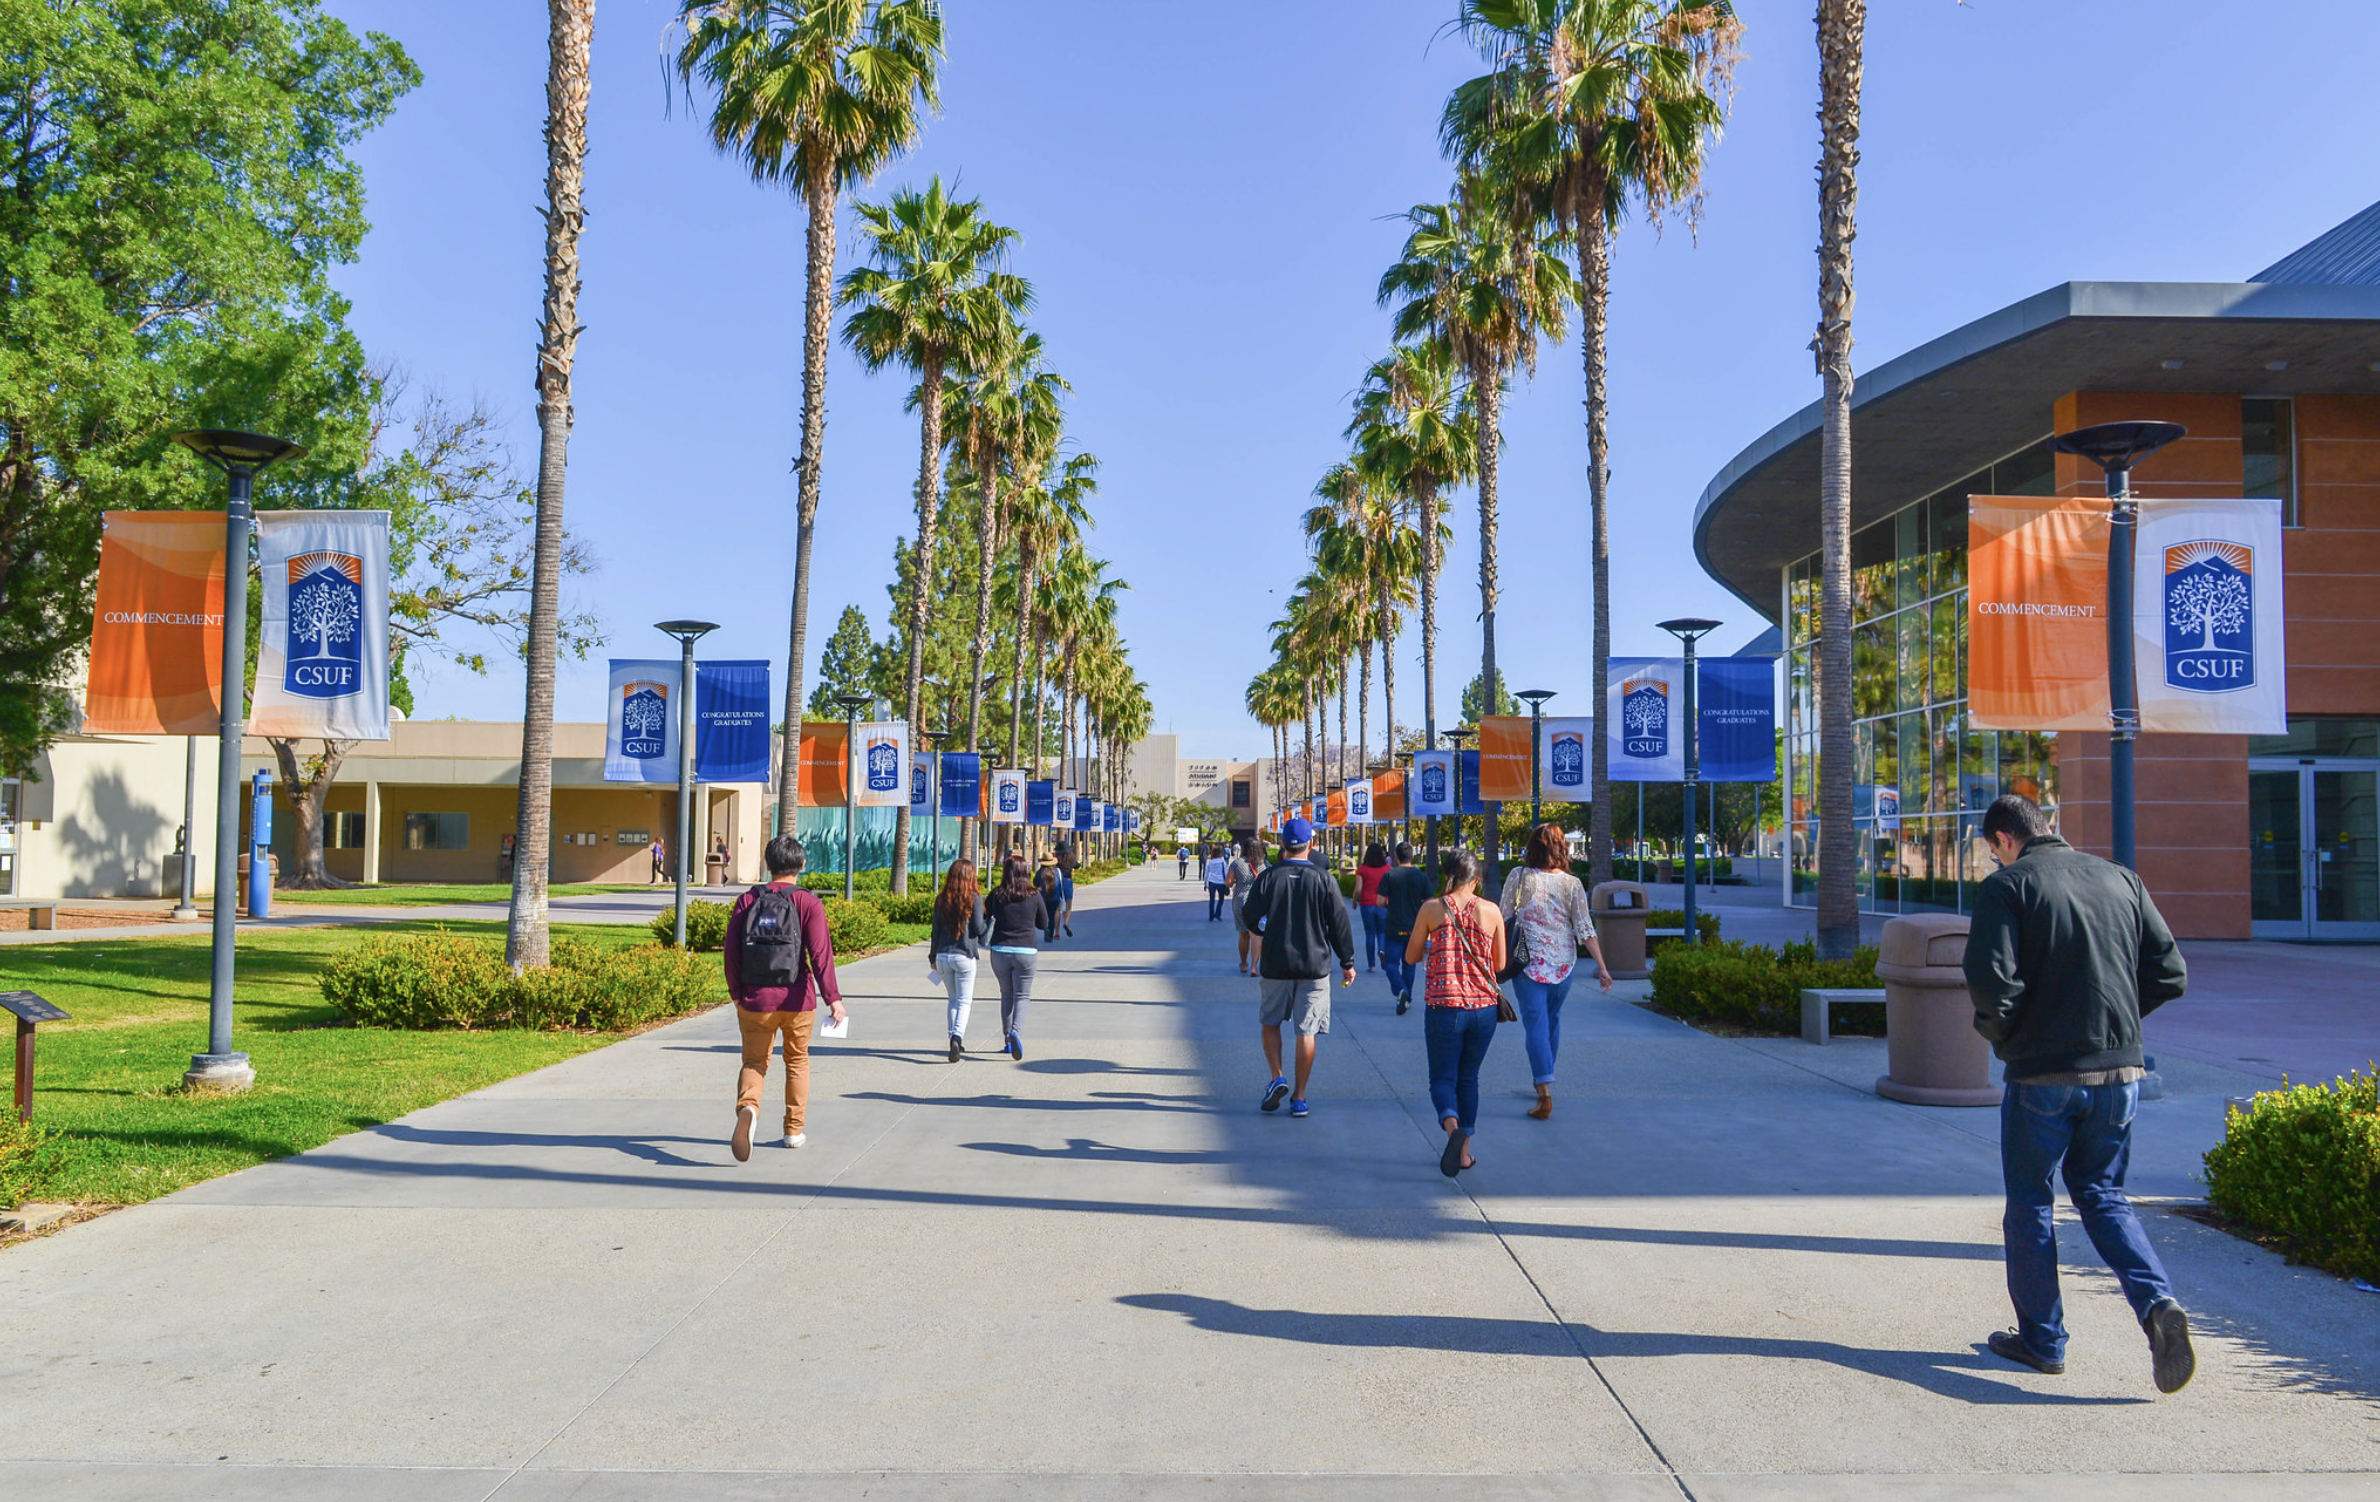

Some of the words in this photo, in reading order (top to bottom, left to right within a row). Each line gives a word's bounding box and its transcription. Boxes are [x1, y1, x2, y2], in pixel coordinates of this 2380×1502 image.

[1978, 602, 2096, 618] COMMENCEMENT
[104, 611, 225, 626] COMMENCEMENT
[2176, 659, 2243, 678] CSUF
[294, 666, 353, 686] CSUF
[701, 711, 765, 719] CONGRATULATIONS
[626, 741, 661, 753] CSUF
[1628, 741, 1663, 753] CSUF
[871, 779, 895, 787] CSUF
[1555, 773, 1580, 782] CSUF
